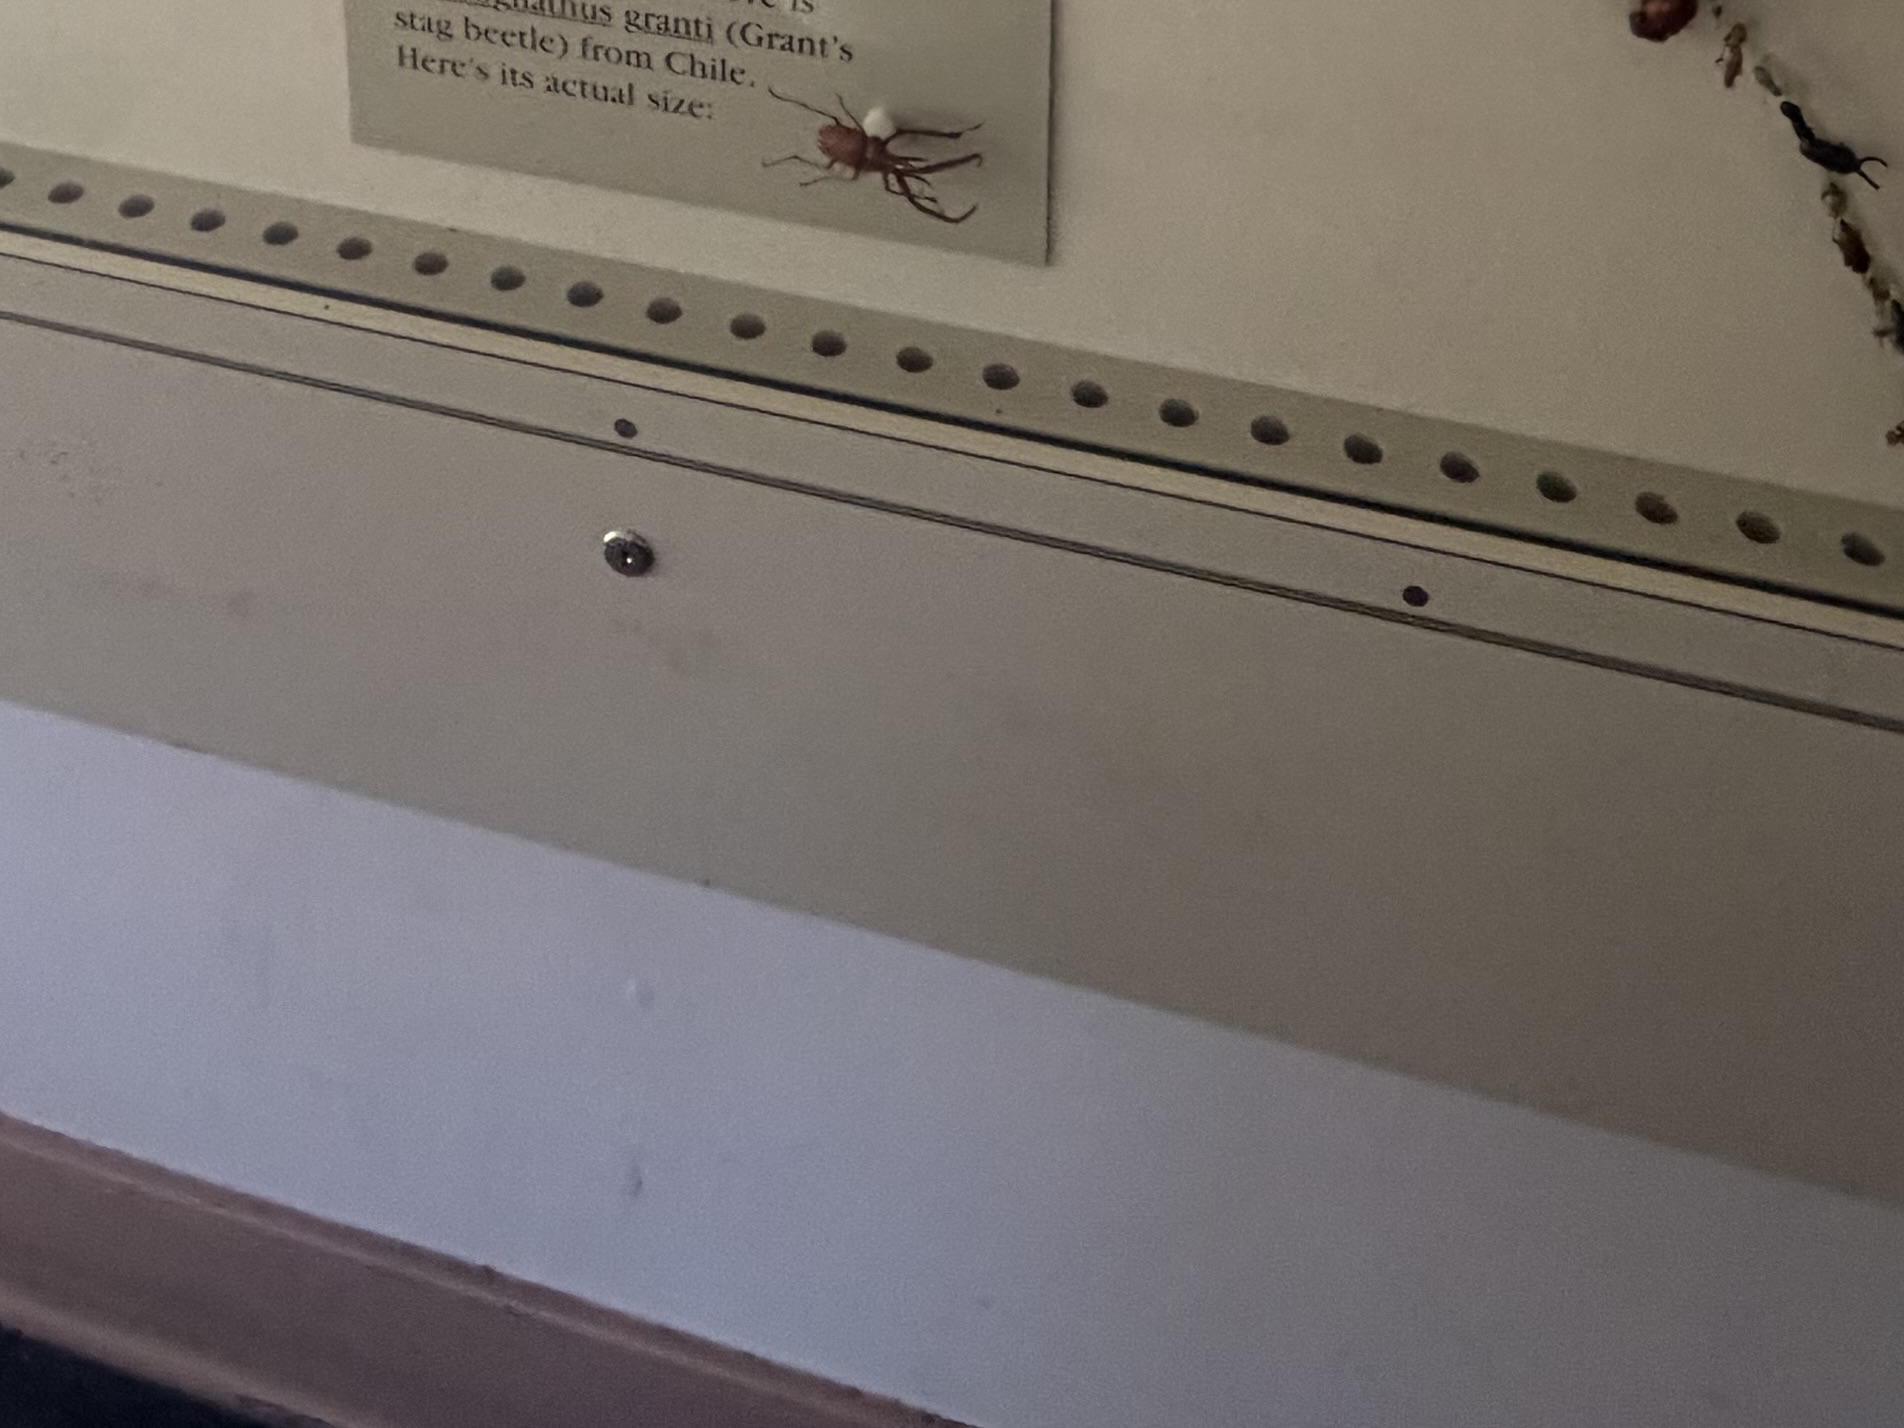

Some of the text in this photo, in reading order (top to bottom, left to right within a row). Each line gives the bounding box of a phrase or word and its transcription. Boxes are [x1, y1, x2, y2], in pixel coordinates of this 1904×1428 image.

[394, 11, 755, 87] stag beetle) from Chile.
[624, 9, 714, 41] granti
[726, 21, 853, 62] (Grant's
[397, 45, 713, 120] Here's its actual size:
